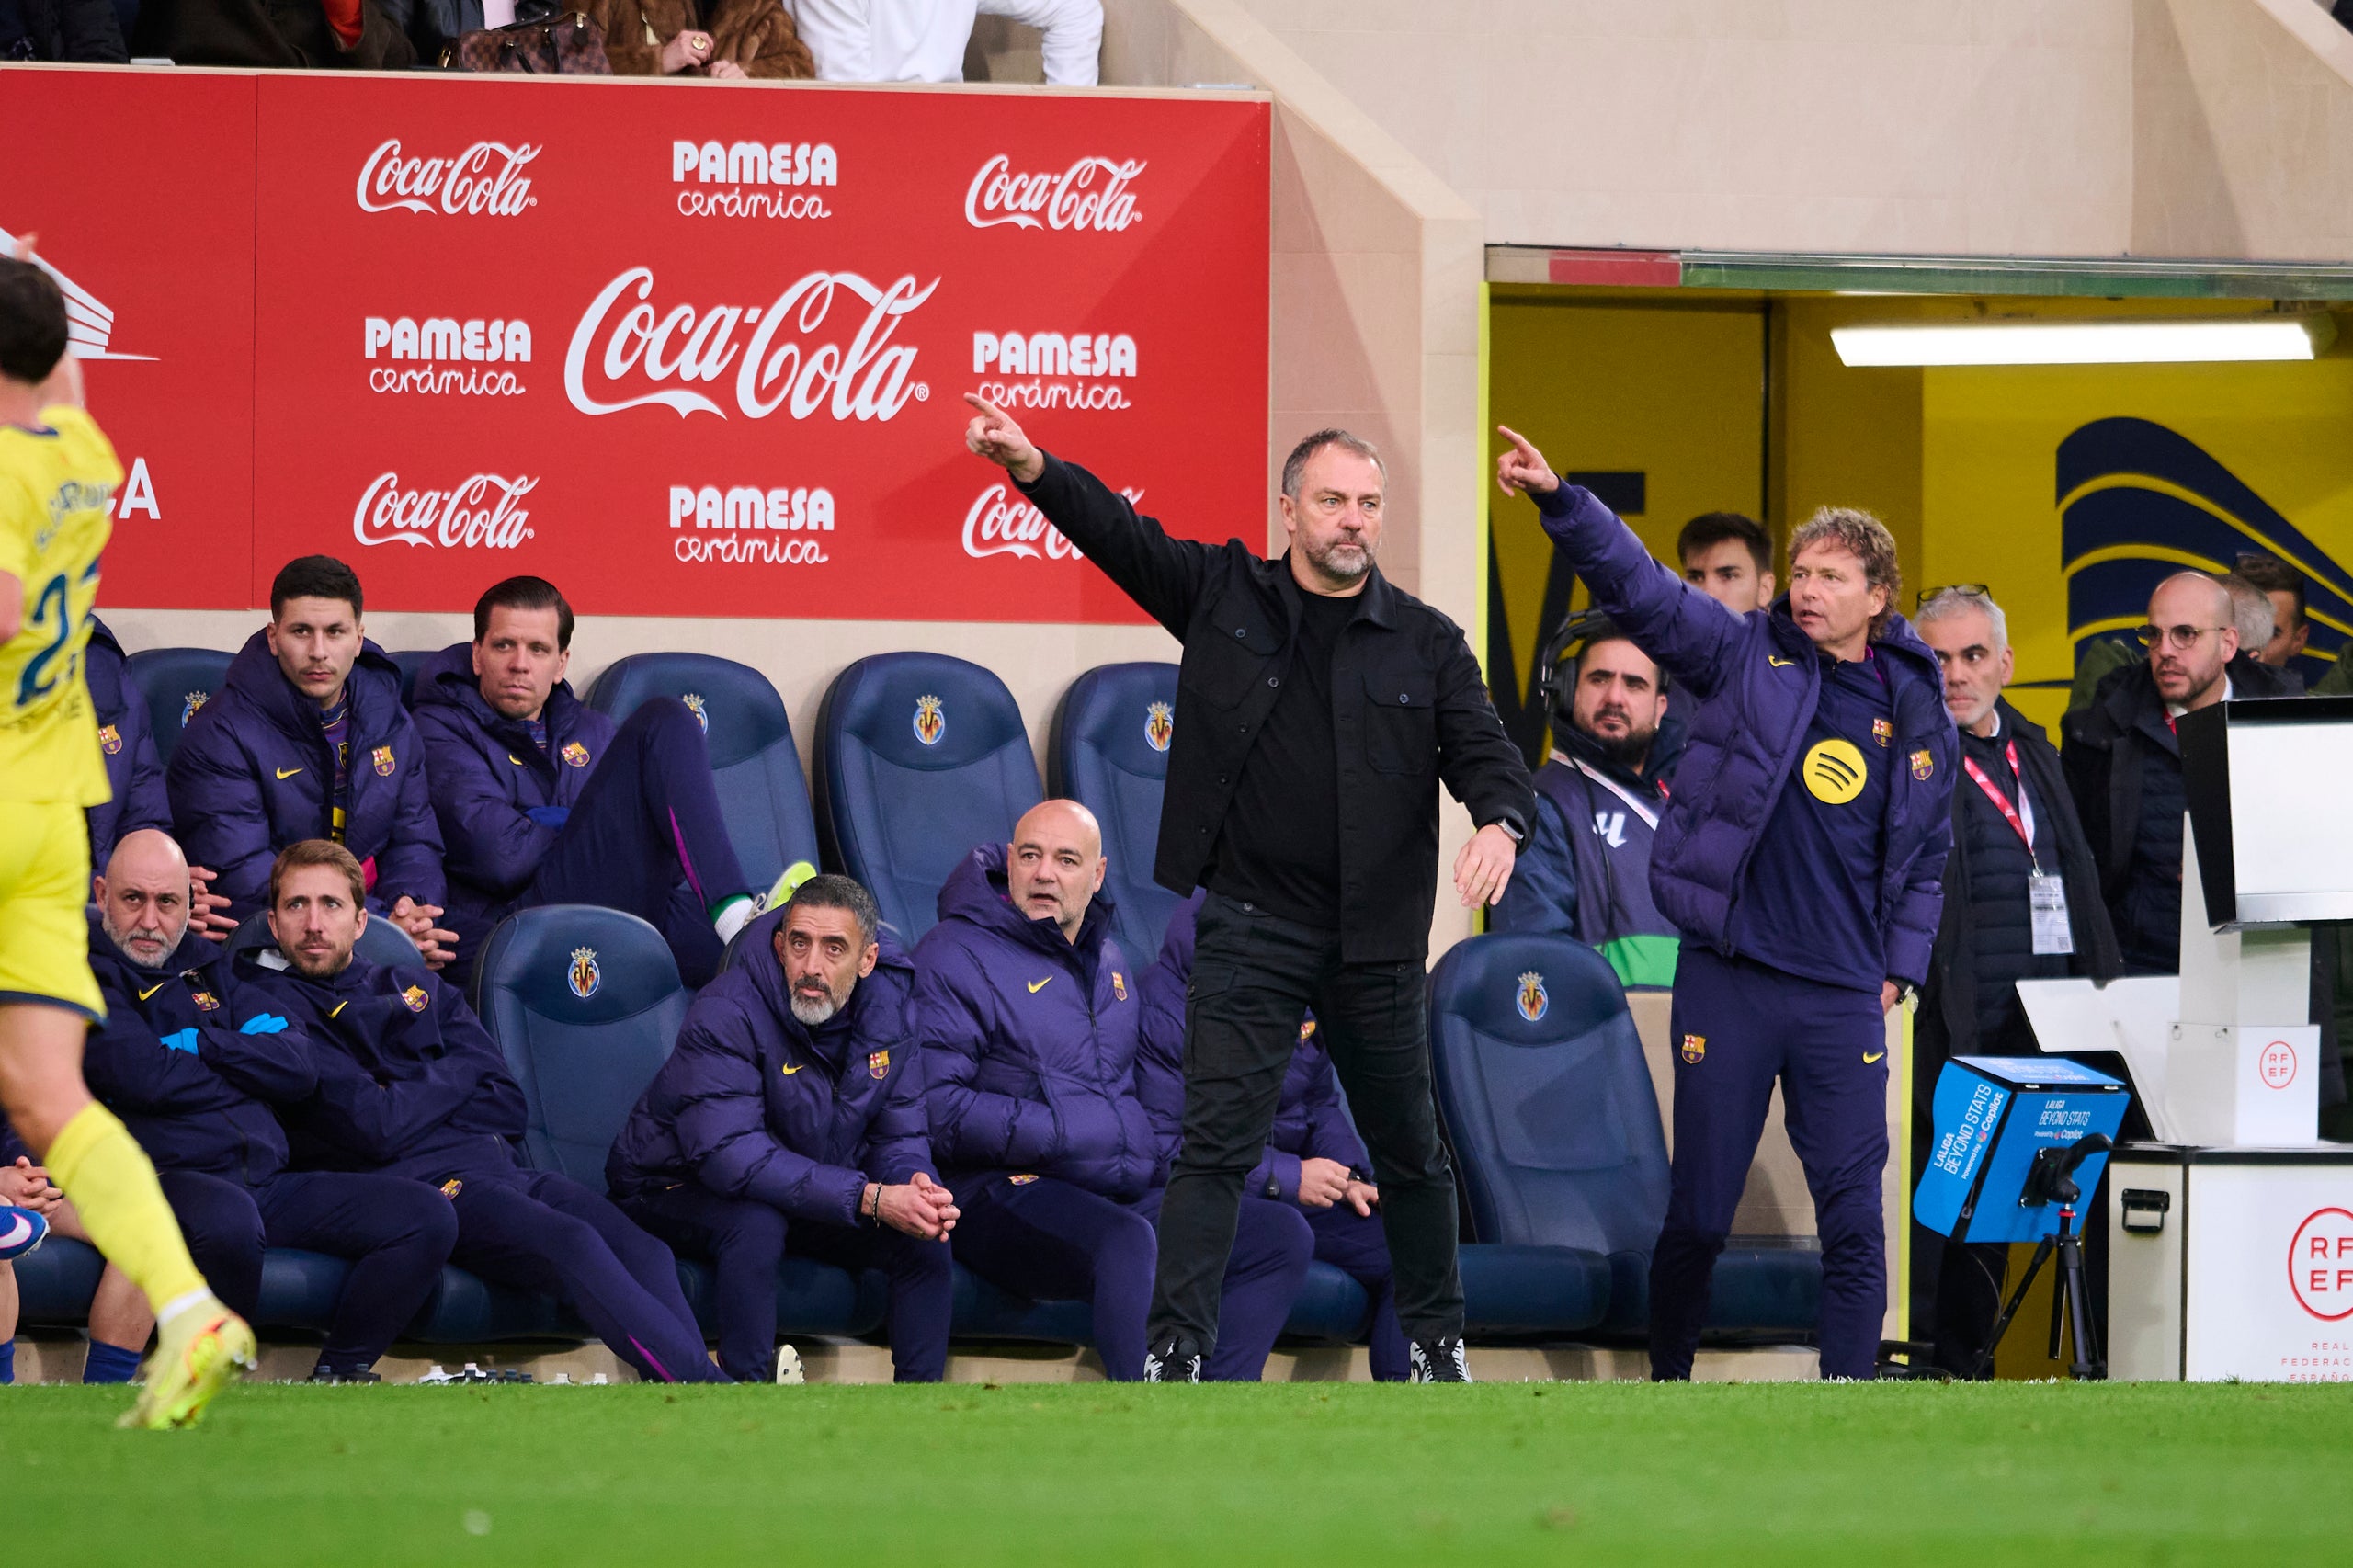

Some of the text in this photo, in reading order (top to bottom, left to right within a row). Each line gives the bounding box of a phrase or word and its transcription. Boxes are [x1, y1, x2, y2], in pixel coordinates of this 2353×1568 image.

[673, 142, 838, 186] PAMESA
[677, 188, 832, 221] cerámica
[365, 318, 532, 362] PAMESA
[973, 332, 1137, 378] PAMESA
[369, 366, 527, 396] cerámica
[670, 486, 835, 531] PAMESA
[674, 536, 830, 566] cerámica
[1943, 1084, 1992, 1175] BEYOND STATS
[1961, 1092, 2004, 1180] Powered by Copilot
[2039, 1111, 2091, 1126] BEYOND STATS
[1934, 1131, 1955, 1168] LALIGA
